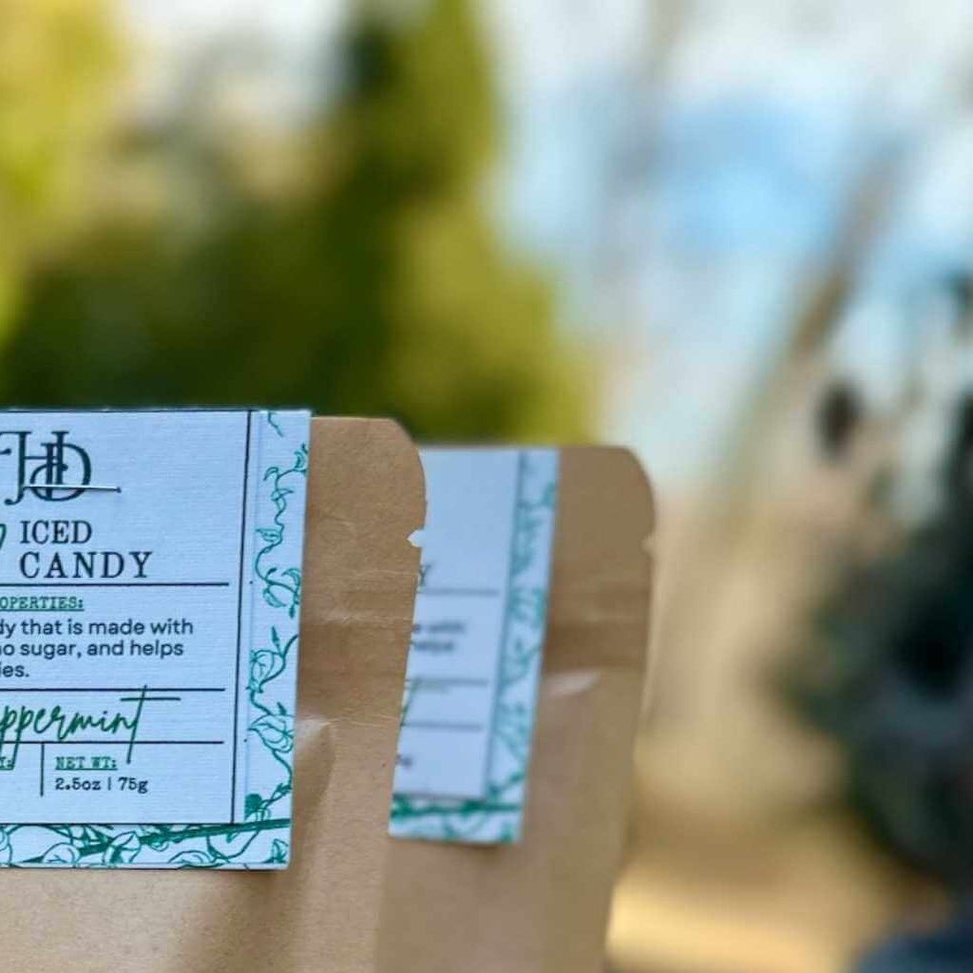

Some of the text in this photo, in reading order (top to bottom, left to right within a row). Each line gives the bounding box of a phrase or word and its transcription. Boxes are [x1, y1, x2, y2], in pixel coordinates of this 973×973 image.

[19, 520, 93, 545] ICED
[19, 551, 153, 579] CANDY
[20, 618, 63, 636] that
[67, 618, 83, 636] is
[88, 618, 145, 635] made
[150, 617, 194, 635] with
[20, 643, 82, 660] sugar,
[87, 640, 124, 656] and
[130, 639, 184, 659] helps
[55, 756, 118, 771] NET WT:
[55, 778, 102, 791] 2.5oz
[117, 777, 149, 794] 75g
